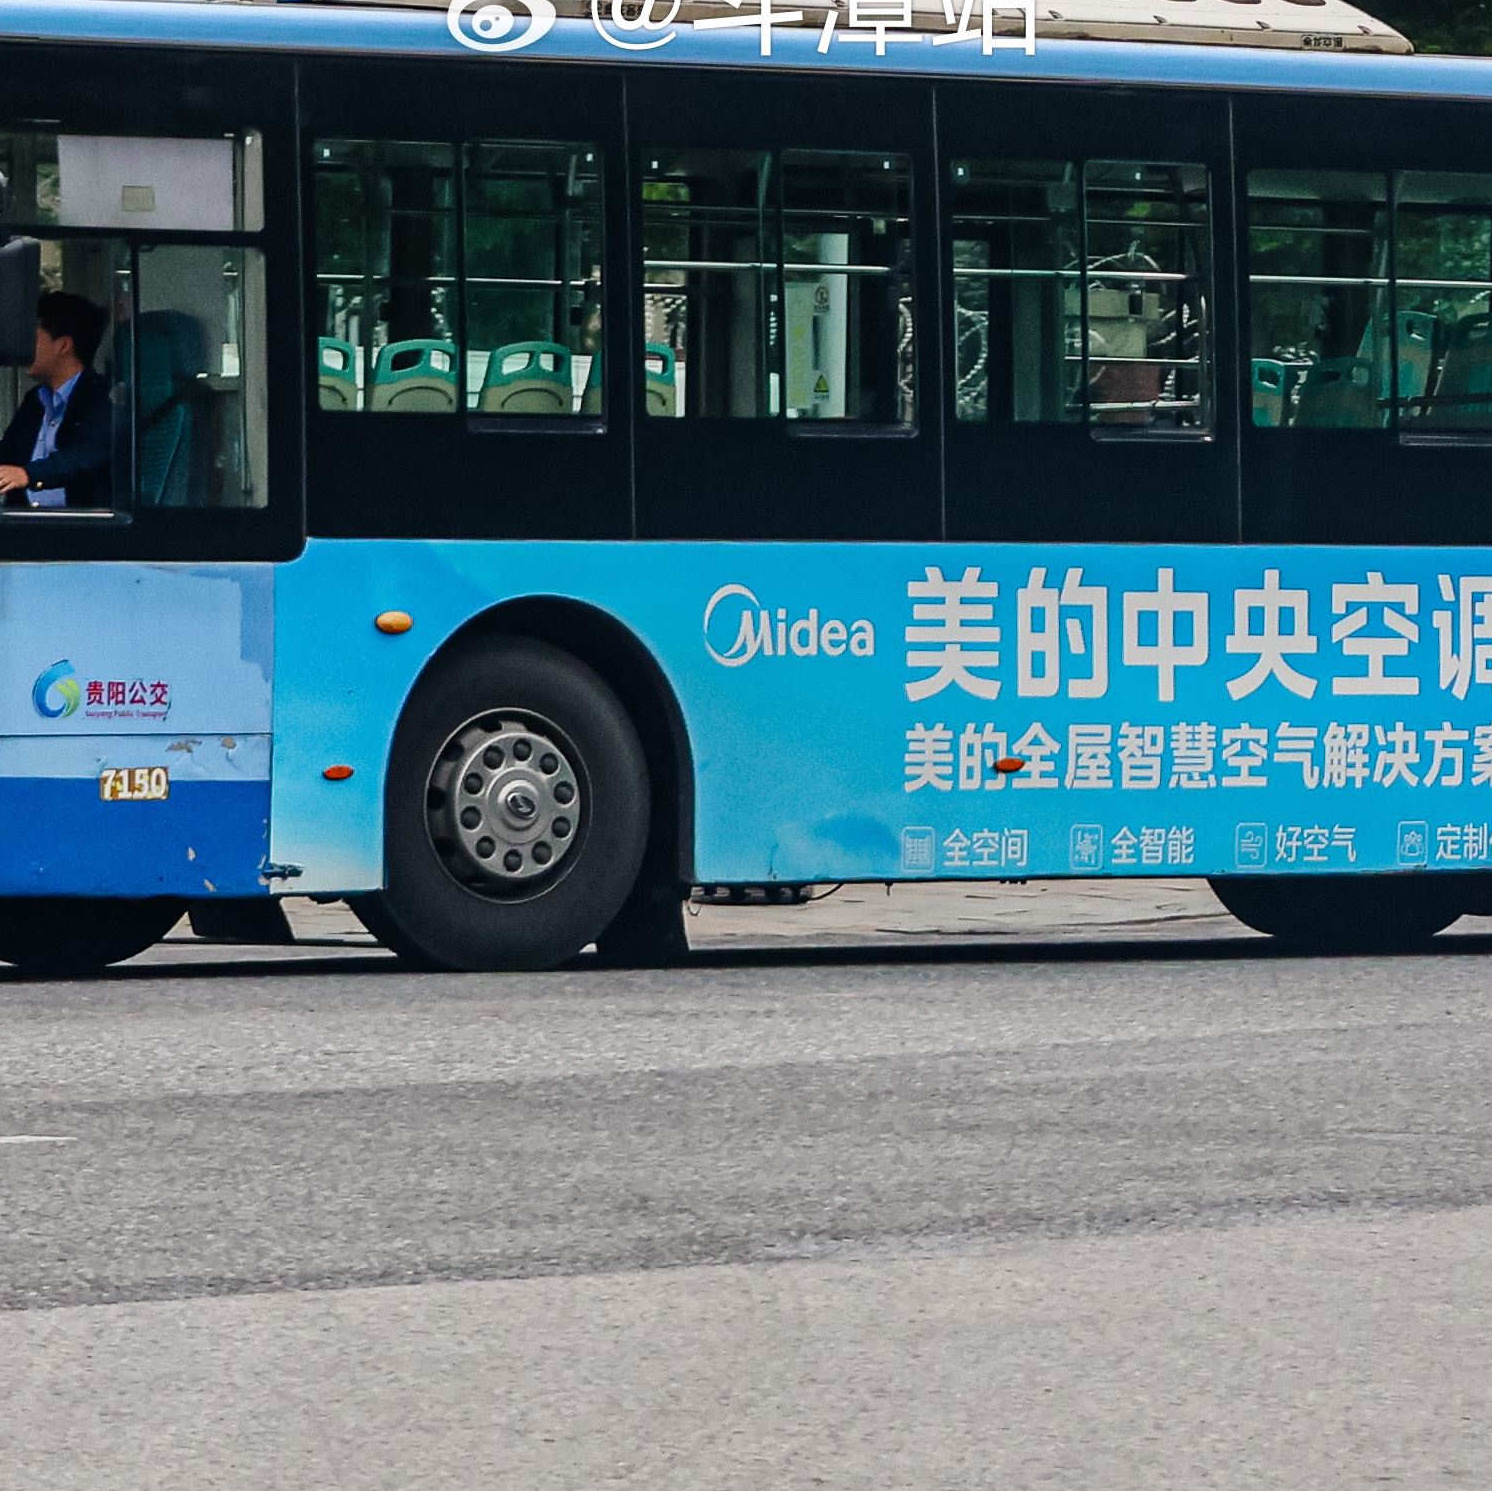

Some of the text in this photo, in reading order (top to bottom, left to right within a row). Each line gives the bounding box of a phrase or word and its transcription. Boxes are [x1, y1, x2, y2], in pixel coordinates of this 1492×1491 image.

[703, 583, 875, 668] Midea
[86, 679, 169, 706] 贵阳公交
[101, 767, 168, 800] 7150
[942, 826, 1029, 867] 全空间
[1110, 826, 1195, 866] 全智能
[1274, 824, 1358, 864] 好空气
